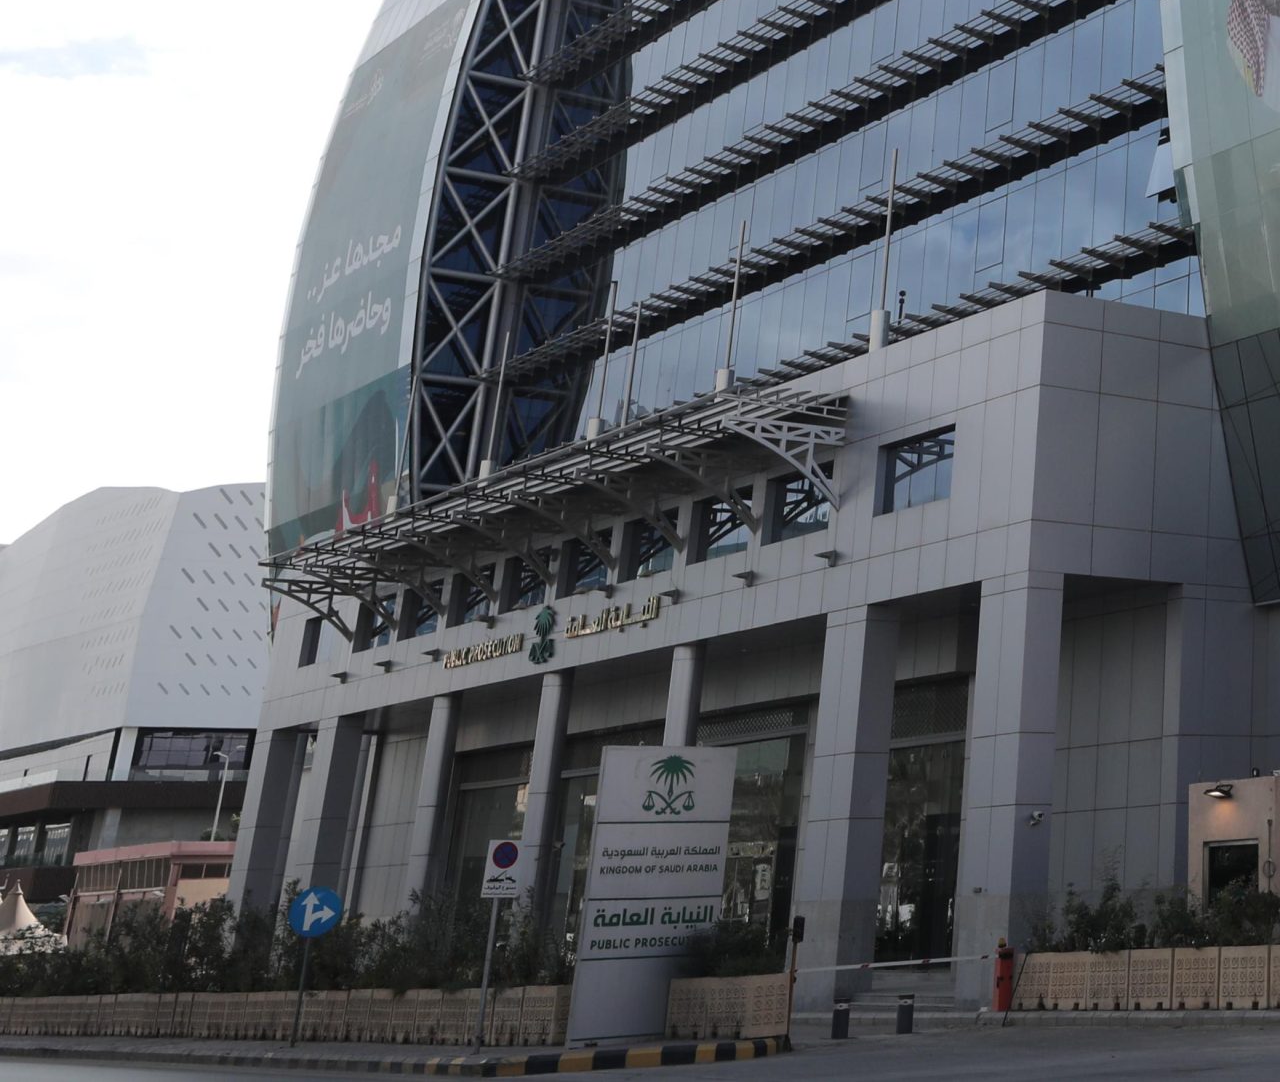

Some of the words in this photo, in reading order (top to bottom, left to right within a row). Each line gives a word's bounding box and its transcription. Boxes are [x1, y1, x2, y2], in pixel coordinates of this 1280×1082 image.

[344, 224, 402, 277] مجدها
[328, 290, 392, 355] وحاضرها
[295, 313, 326, 380] فخر
[602, 847, 648, 860] السعودية
[650, 846, 682, 859] العربية
[683, 845, 721, 856] المملكة
[600, 865, 642, 875] KINGDOM
[644, 865, 656, 874] OF
[658, 864, 684, 873] SAUDI
[686, 863, 718, 873] ARABIA
[593, 907, 655, 928] العامة
[660, 905, 714, 930] النيابة
[590, 938, 631, 950] PUBLIC
